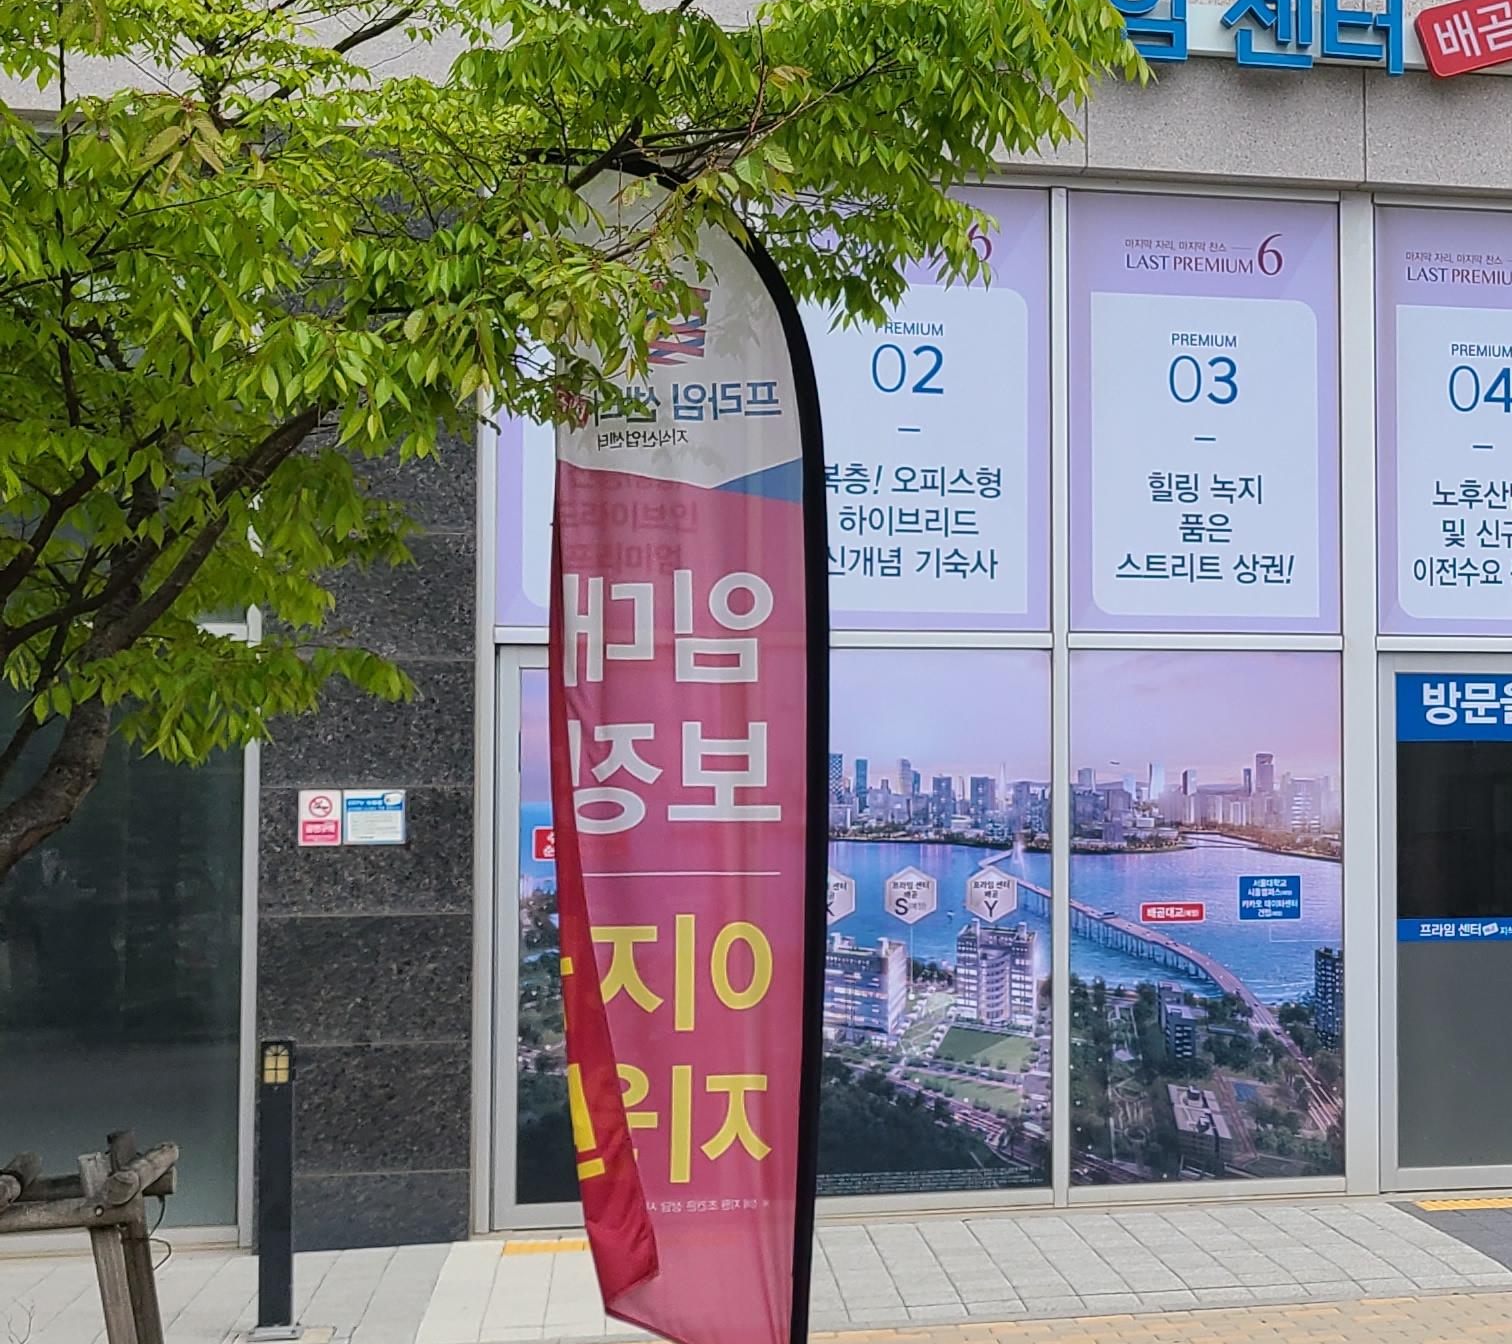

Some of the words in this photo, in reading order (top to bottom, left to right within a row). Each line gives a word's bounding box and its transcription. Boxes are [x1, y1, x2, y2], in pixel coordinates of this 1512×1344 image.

[1126, 253, 1170, 270] LAST
[1173, 256, 1254, 274] PREMIUM
[1257, 233, 1284, 276] 6
[1407, 266, 1449, 282] LAST
[879, 322, 944, 337] REMIUM
[1171, 333, 1237, 347] PREMIUM
[1451, 344, 1512, 357] PREMIUM
[871, 343, 944, 394] 02
[1169, 355, 1239, 404] 03
[891, 465, 1002, 499] 오피스형
[1148, 472, 1199, 504] 힐링
[1210, 474, 1263, 505] 녹지
[838, 505, 980, 538] 하이브리드
[1179, 513, 1233, 543] 품은
[1441, 519, 1466, 548] 및
[916, 548, 999, 579] 기숙사
[1115, 552, 1224, 583] 스트리트
[1232, 554, 1295, 585] 상권!
[1413, 557, 1503, 587] 이전수요
[984, 900, 998, 917] Y
[1420, 923, 1455, 937] 프라임
[1458, 923, 1481, 937] 센터
